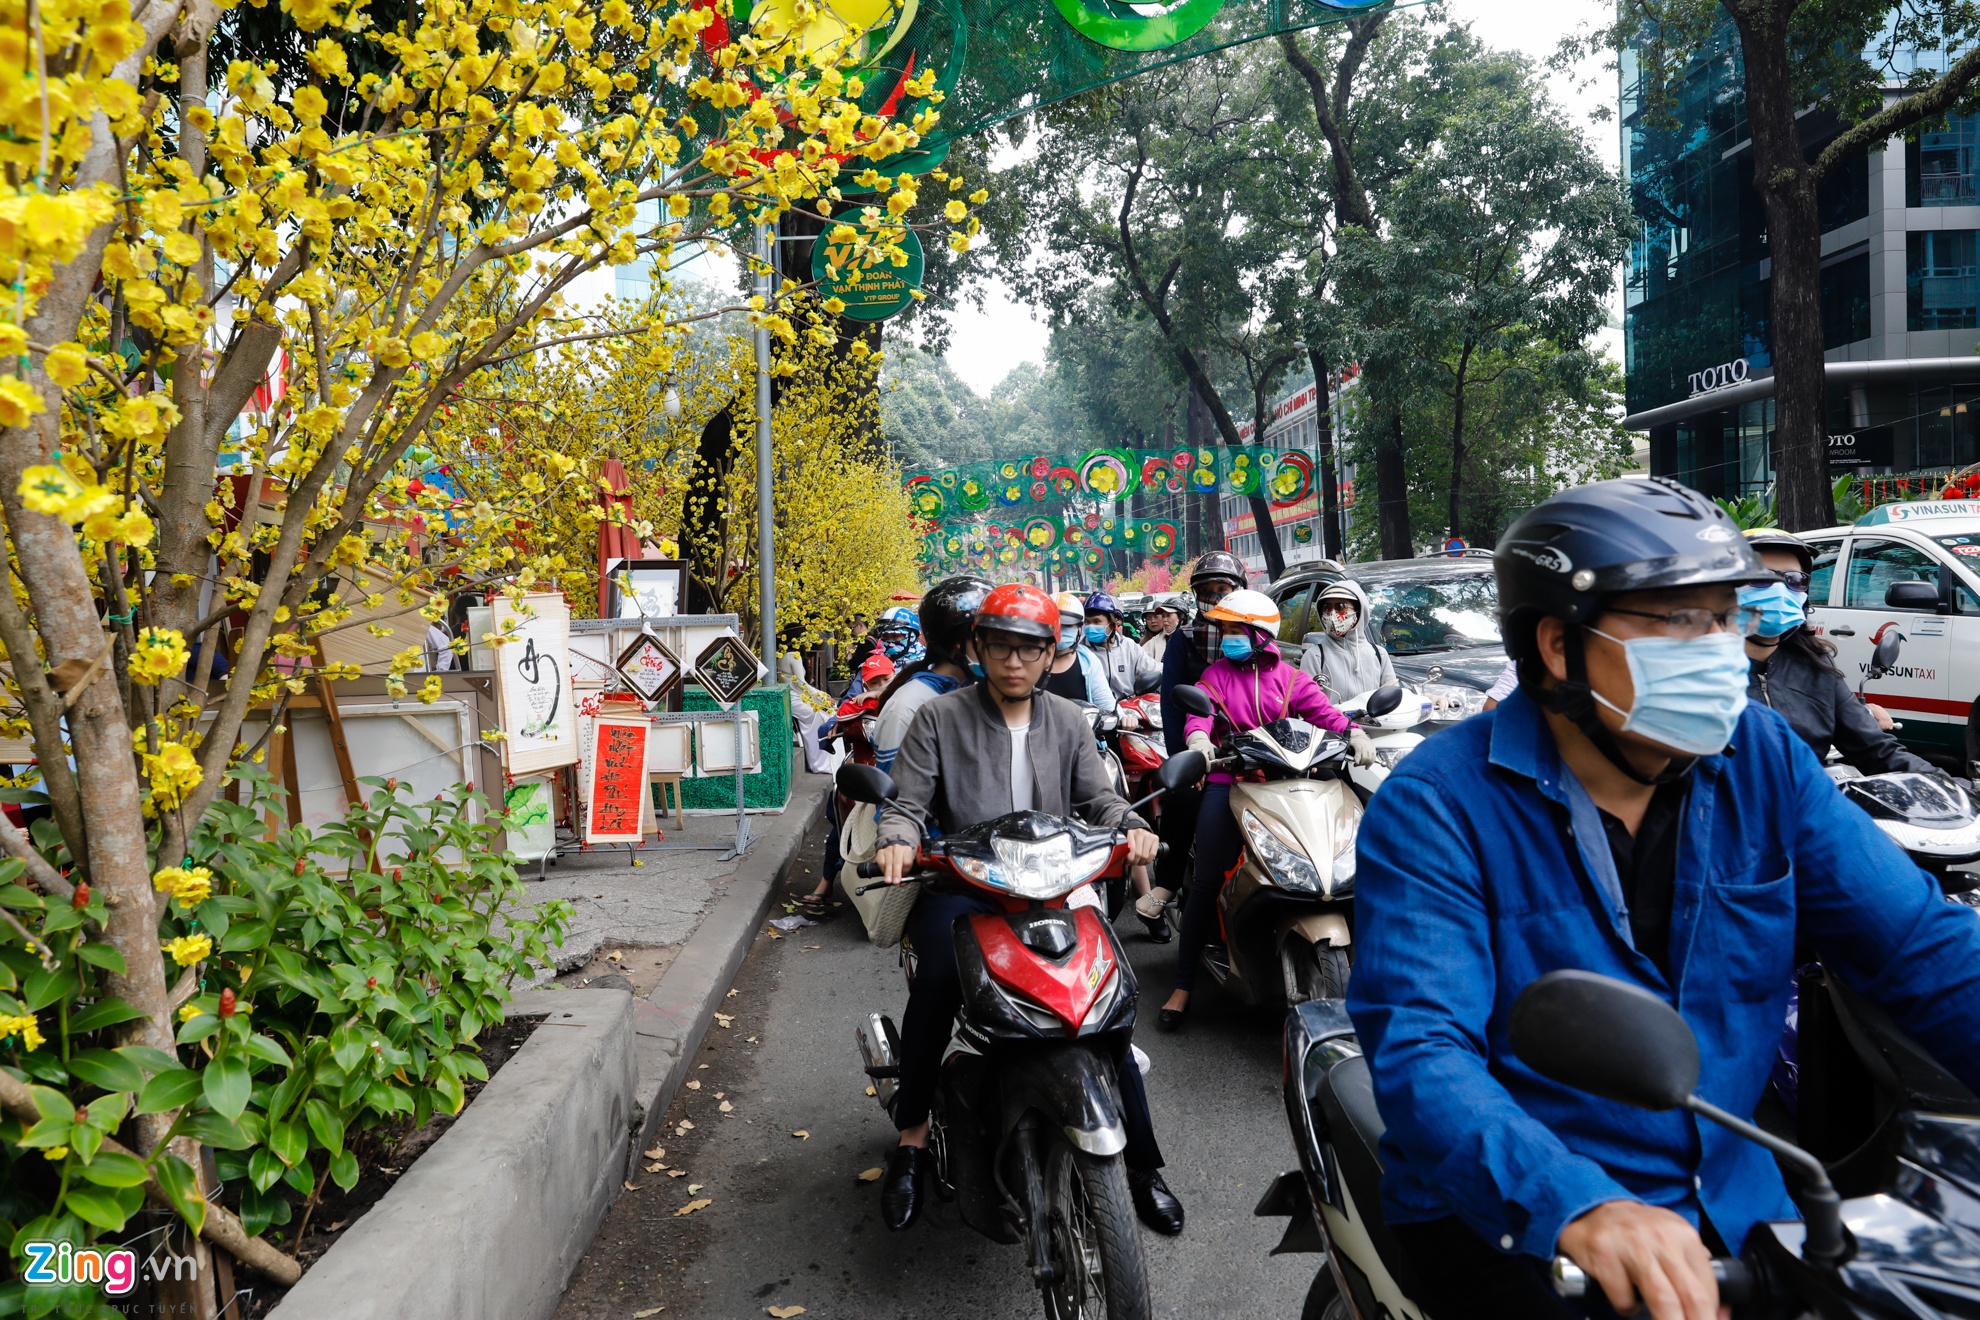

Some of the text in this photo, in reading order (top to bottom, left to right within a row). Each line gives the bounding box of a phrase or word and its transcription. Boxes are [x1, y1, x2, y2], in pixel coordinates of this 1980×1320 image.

[846, 272, 864, 281] TP
[832, 285, 852, 294] VẠN
[854, 282, 881, 292] THỊNH
[1688, 358, 1748, 394] TOTO
[1828, 434, 1856, 446] OTO
[1911, 504, 1968, 515] VINASUN
[1859, 663, 1913, 678] VISUN
[1029, 918, 1067, 929] HONDA
[965, 1023, 991, 1044] HONDA
